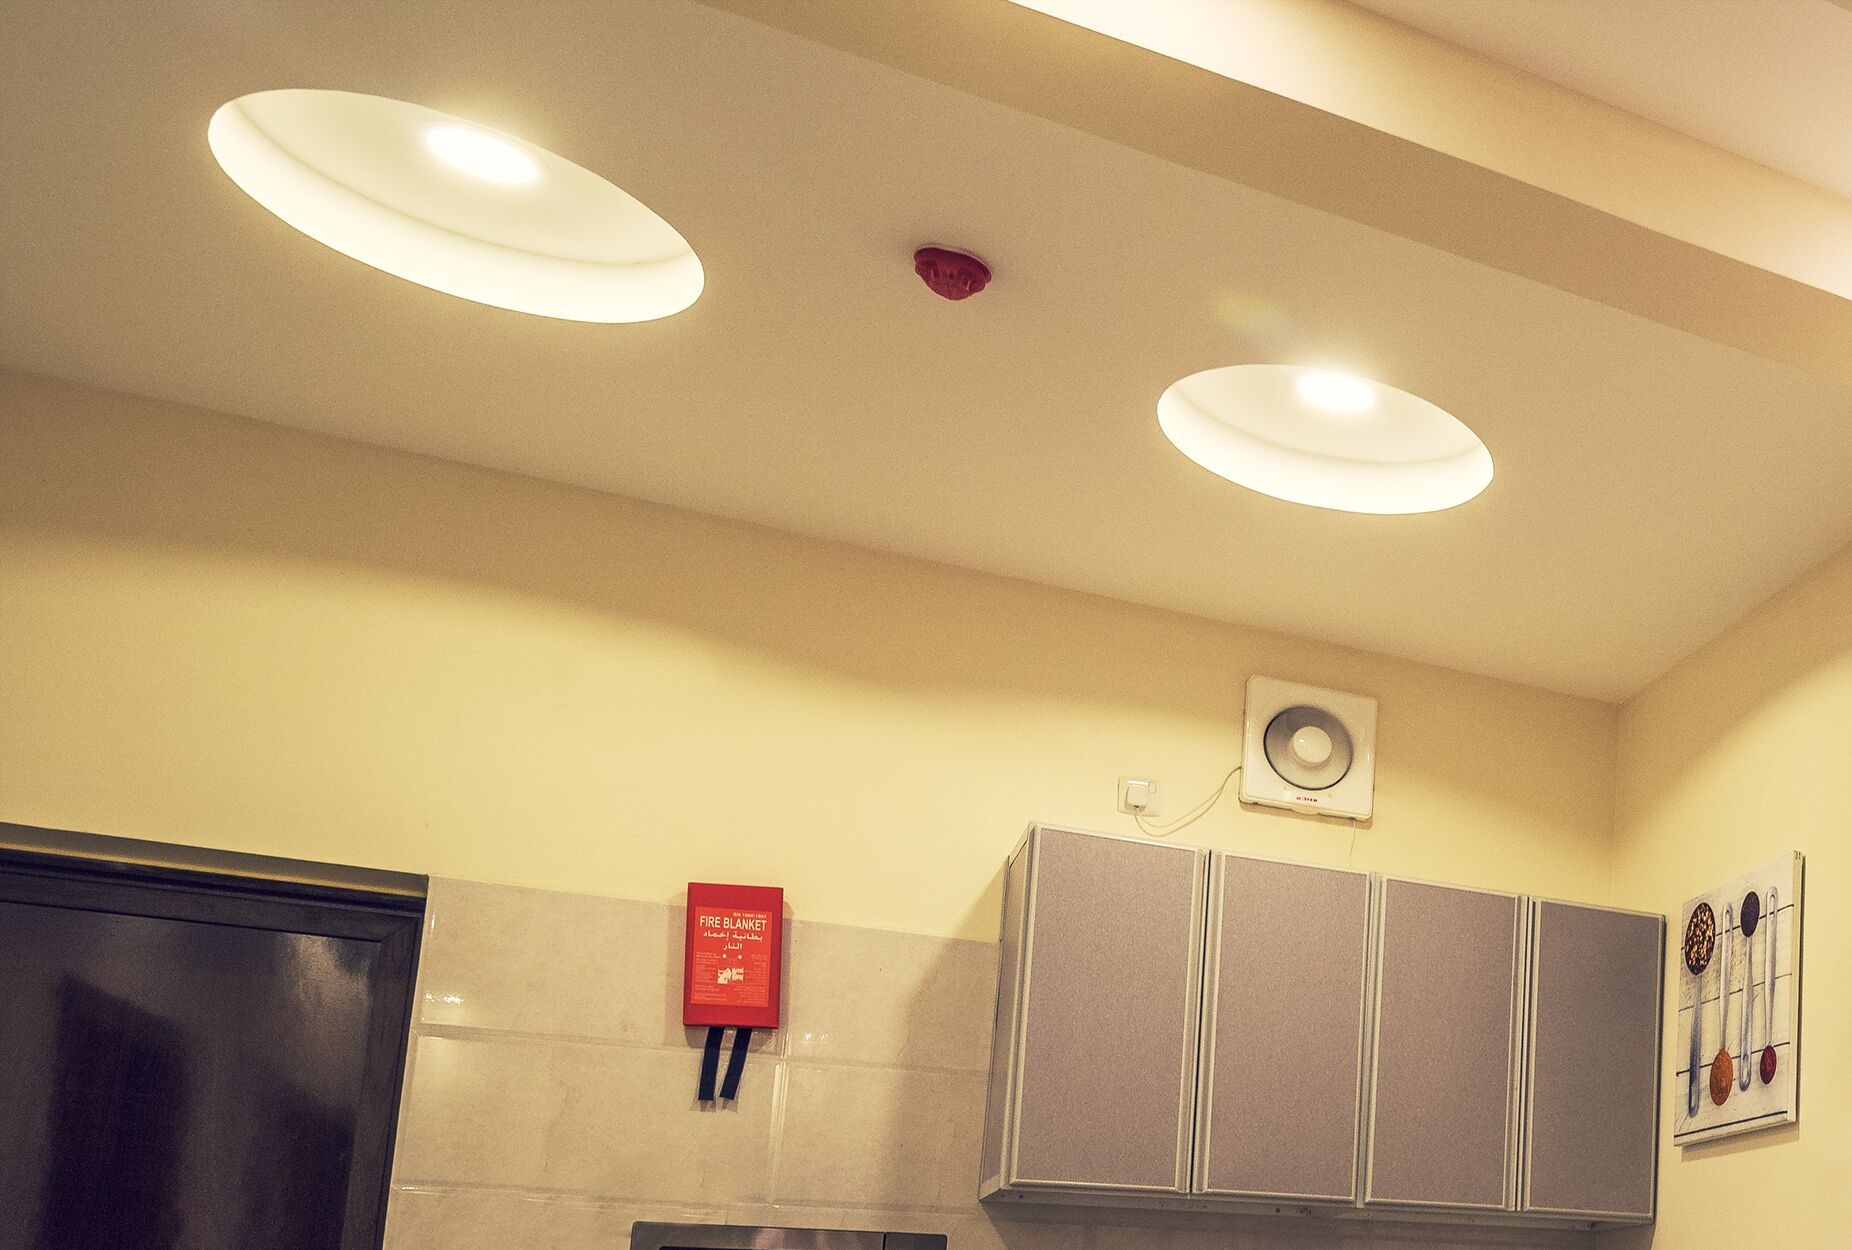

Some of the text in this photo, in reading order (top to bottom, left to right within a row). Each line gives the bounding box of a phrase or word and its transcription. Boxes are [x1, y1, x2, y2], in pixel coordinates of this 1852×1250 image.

[700, 915, 767, 931] FIRE BLANKET
[703, 930, 763, 943] بطانية إخماد
[723, 942, 743, 951] النار
